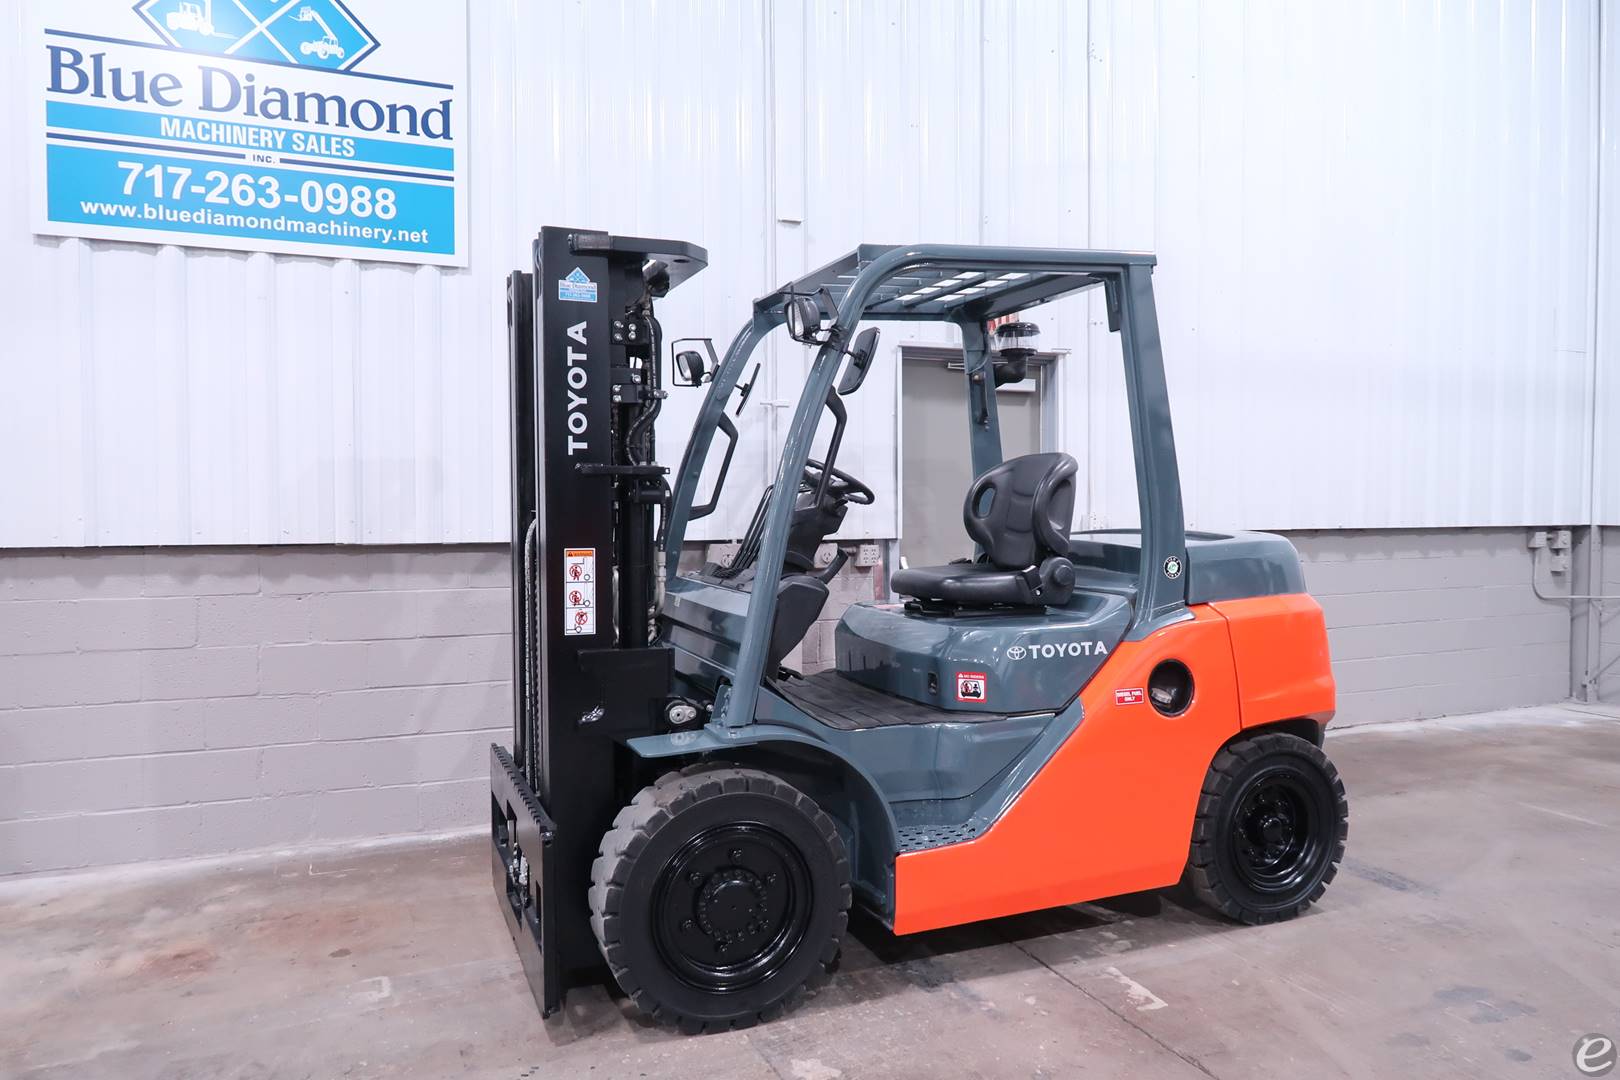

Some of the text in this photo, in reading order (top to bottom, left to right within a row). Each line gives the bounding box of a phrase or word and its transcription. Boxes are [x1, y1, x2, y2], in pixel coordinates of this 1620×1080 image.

[46, 45, 453, 140] Blue Diamond
[160, 117, 355, 158] MACHINERY SALES
[252, 154, 276, 164] INC.
[117, 161, 397, 220] 717-263-0988
[80, 200, 429, 244] www.bluediamondmachinery.net
[566, 320, 588, 455] TOYOTA
[1028, 641, 1108, 659] TOYOTA
